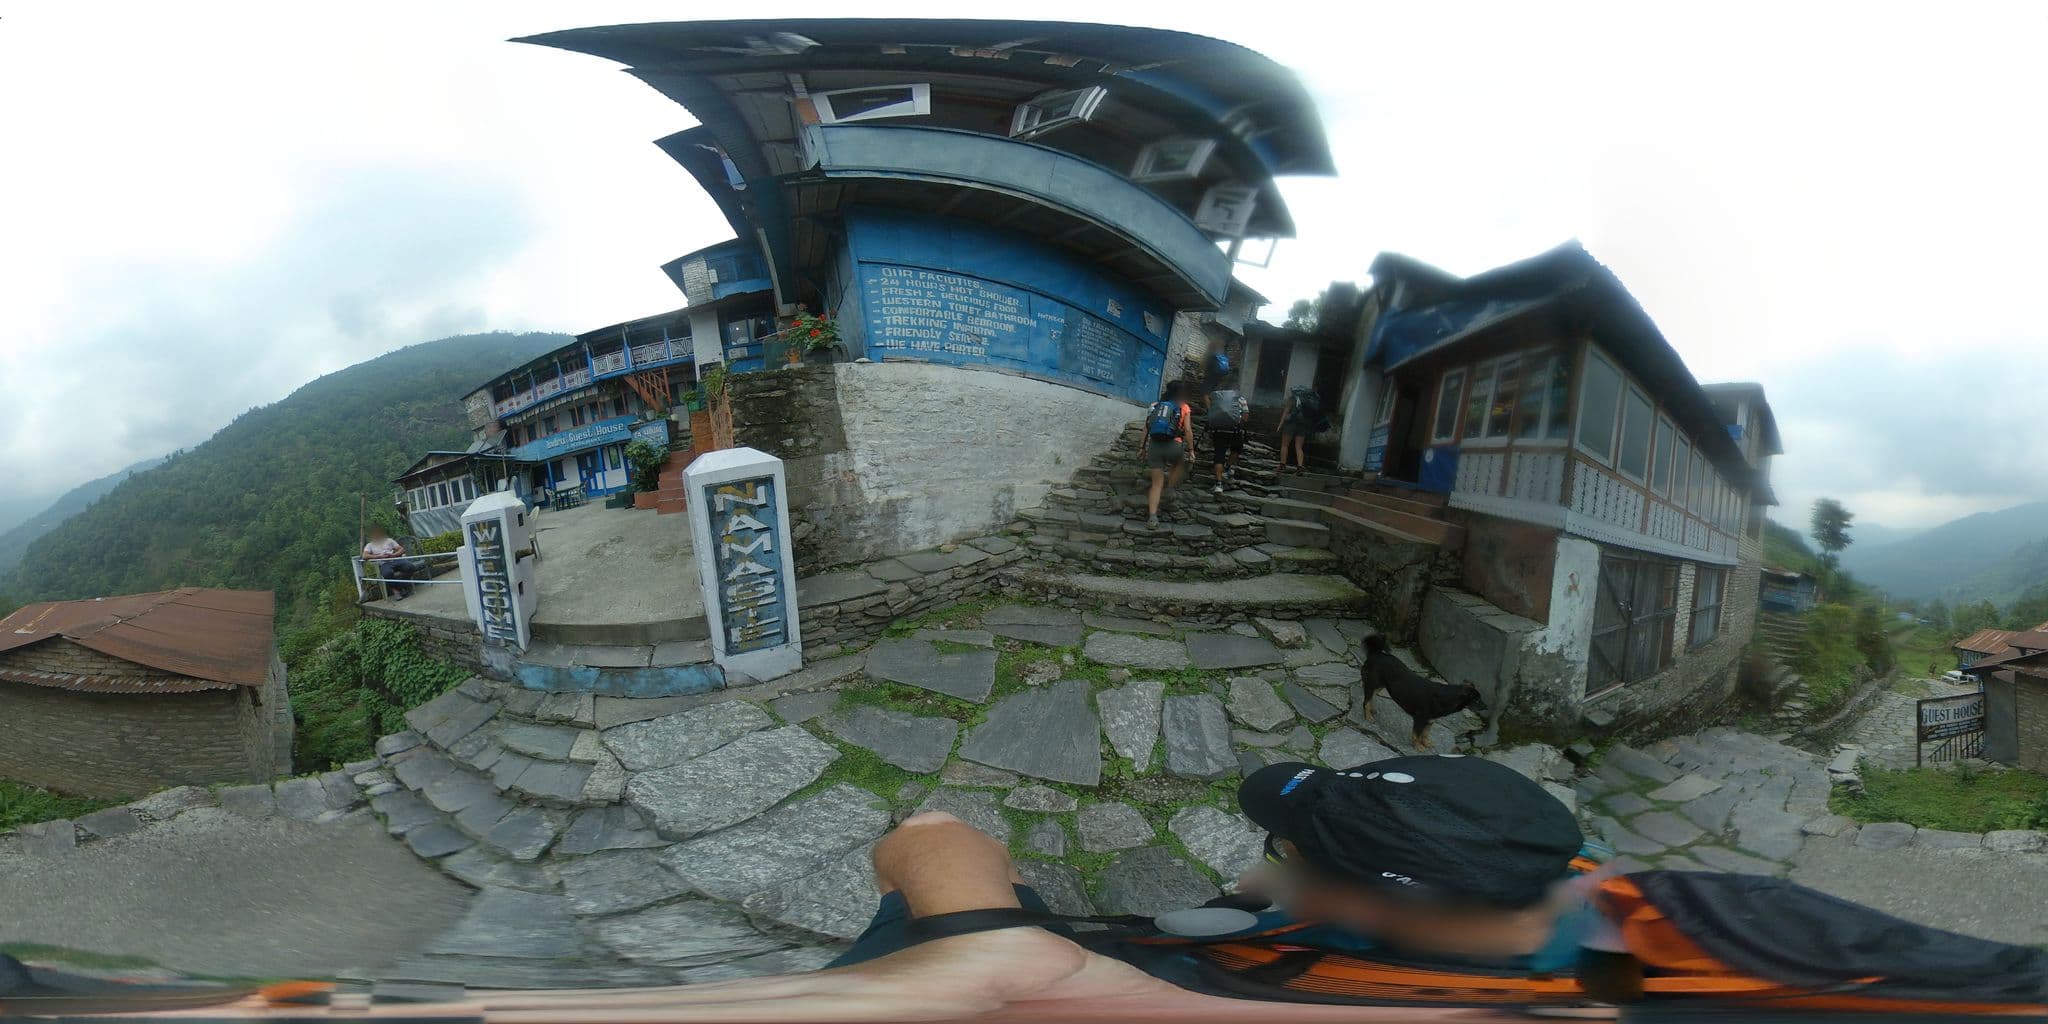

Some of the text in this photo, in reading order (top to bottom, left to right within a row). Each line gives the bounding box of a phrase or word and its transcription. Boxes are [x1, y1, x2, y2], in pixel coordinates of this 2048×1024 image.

[882, 267, 913, 278] OUR
[880, 277, 899, 286] 24
[906, 279, 946, 292] HOURS
[950, 285, 973, 295] HOT
[881, 287, 921, 296] FRESH
[941, 292, 990, 308] DELICIOUS
[882, 297, 941, 308] WESTERN
[985, 310, 1037, 328] BATHROOM
[882, 306, 963, 320] COMFORTABLE
[883, 315, 948, 329] TREKKING
[885, 327, 942, 340] FRIENDLY
[886, 339, 906, 351] WE
[911, 340, 941, 352] HAVE
[569, 429, 593, 442] Guest
[595, 422, 625, 436] House
[714, 482, 781, 648] NAMASTE
[472, 522, 515, 641] WELCOME
[1920, 700, 1984, 724] GUEST HOUSE
